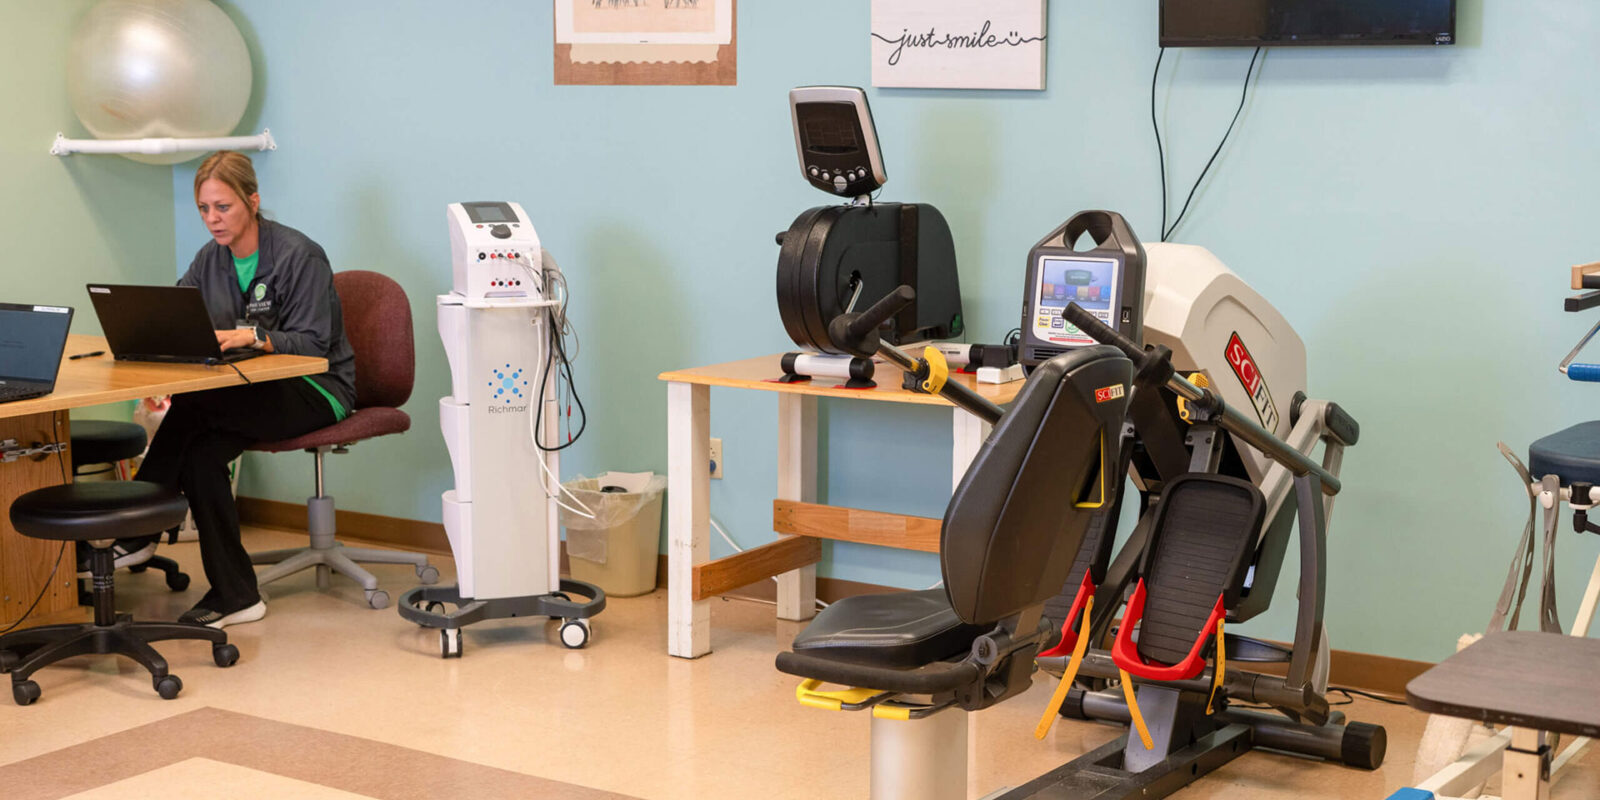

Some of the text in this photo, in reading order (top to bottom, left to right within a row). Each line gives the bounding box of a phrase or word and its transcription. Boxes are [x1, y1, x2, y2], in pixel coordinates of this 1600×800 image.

[888, 20, 1001, 66] just smile
[488, 405, 527, 414] Richmar
